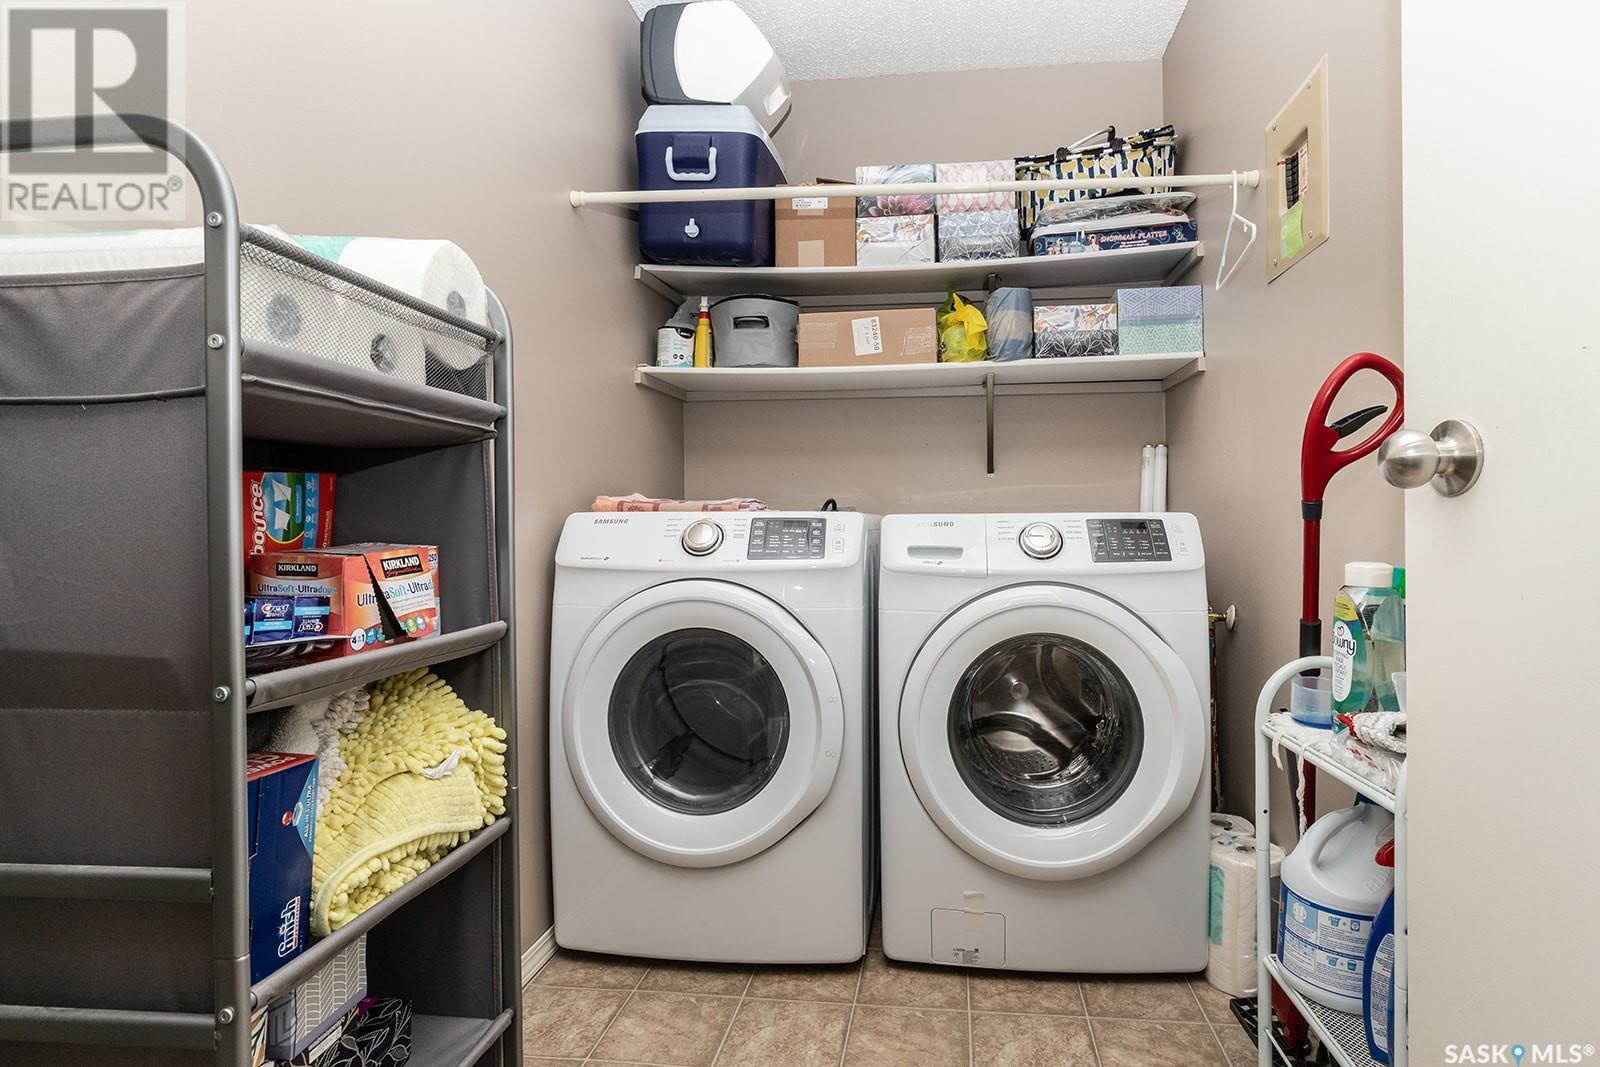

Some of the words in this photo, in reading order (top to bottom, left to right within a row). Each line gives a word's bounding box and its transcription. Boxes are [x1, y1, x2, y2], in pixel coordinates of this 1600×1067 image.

[250, 482, 267, 555] bounce
[278, 564, 317, 572] KIRKLAND
[382, 556, 420, 571] KIRKLAND
[278, 896, 298, 958] finish
